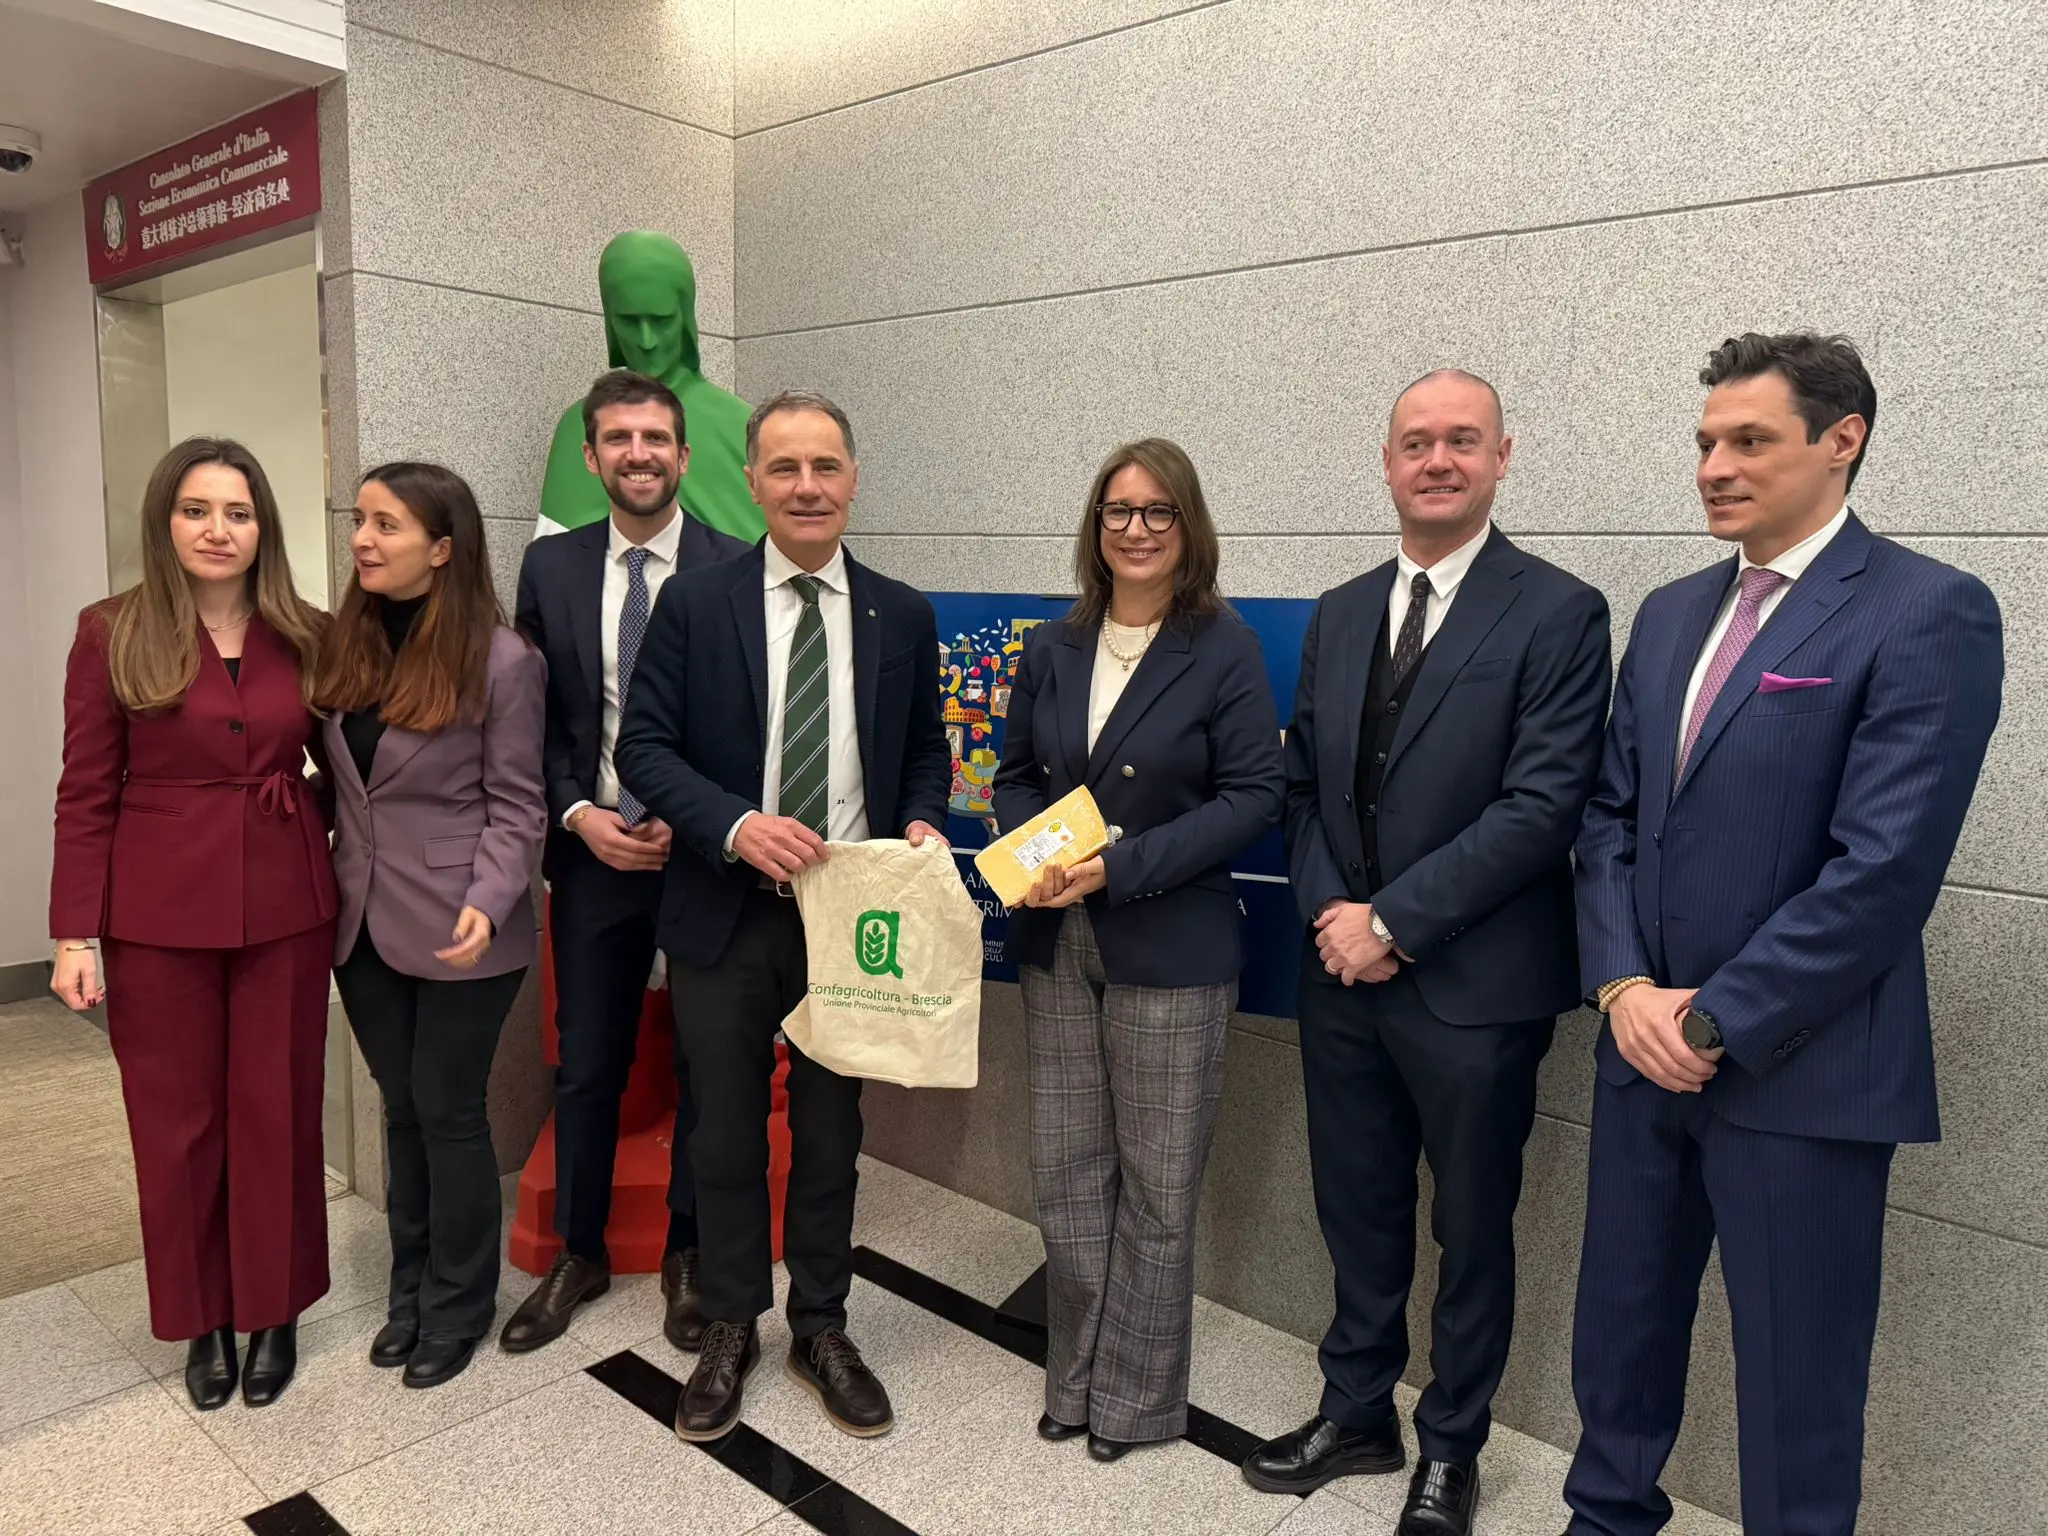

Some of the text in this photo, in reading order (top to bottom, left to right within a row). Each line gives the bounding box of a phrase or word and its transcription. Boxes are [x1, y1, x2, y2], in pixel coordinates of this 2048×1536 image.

[150, 126, 271, 189] Consolato Generale d'Italia
[139, 144, 289, 216] Sezione Economica Commerciale
[808, 983, 901, 1002] Confagricoltura
[912, 994, 952, 1006] Brescia
[822, 998, 937, 1018] Unione Provinciale Agricoltori
